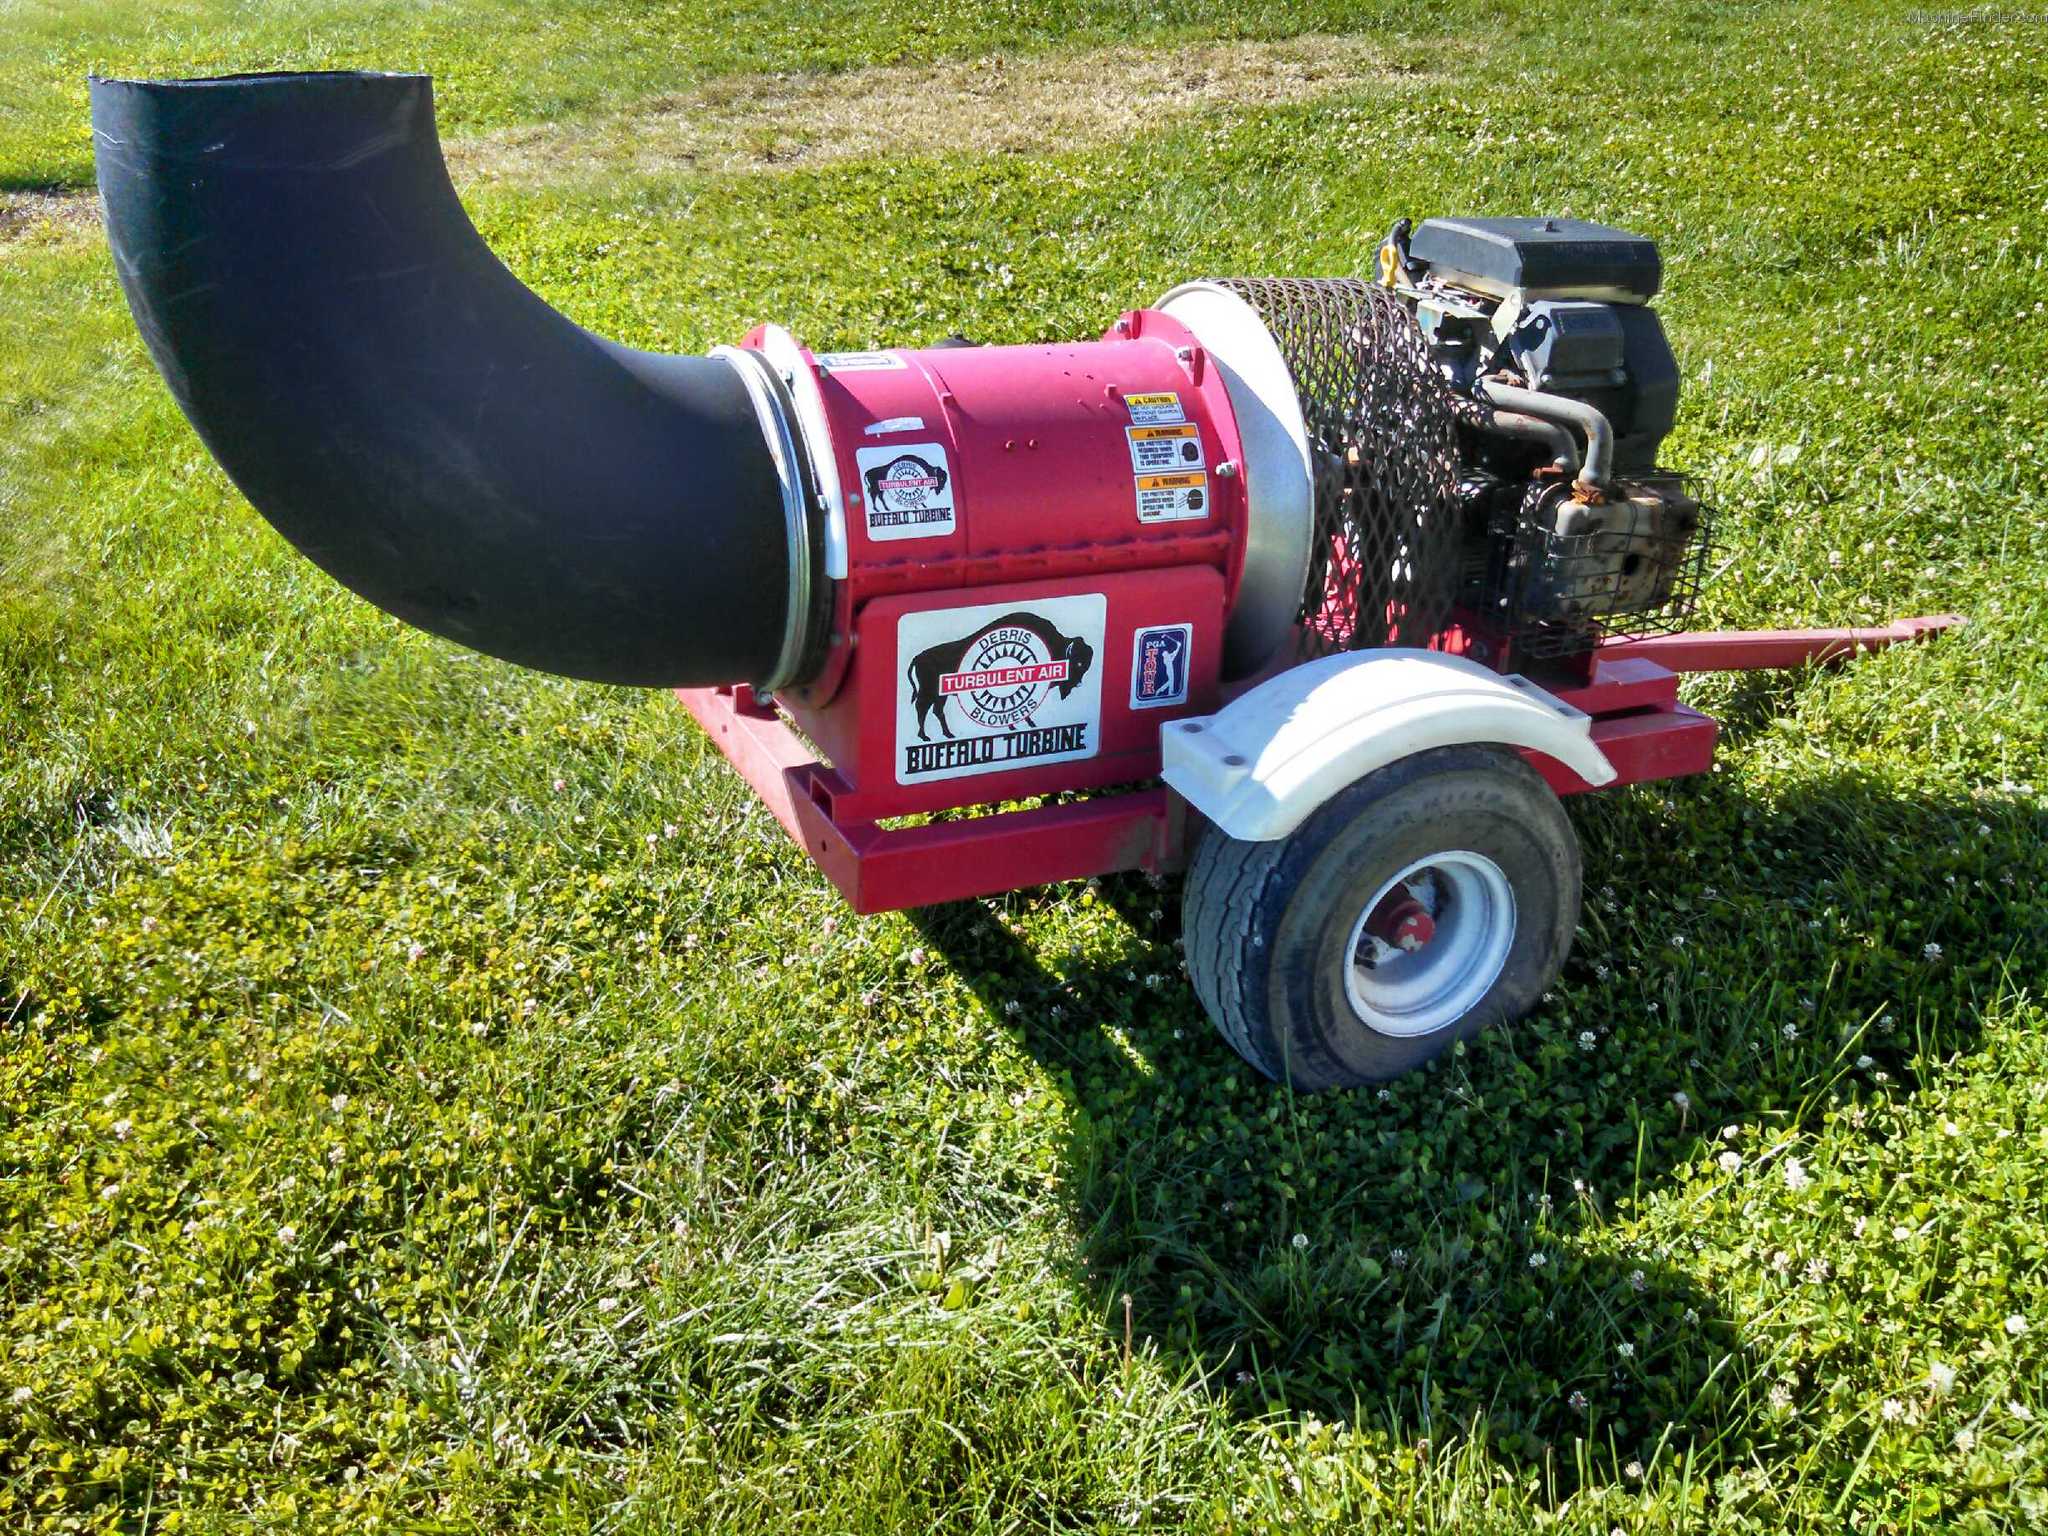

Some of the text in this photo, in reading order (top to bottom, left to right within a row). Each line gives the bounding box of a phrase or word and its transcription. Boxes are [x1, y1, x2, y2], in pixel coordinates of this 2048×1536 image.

[1155, 429, 1183, 437] WARNING
[881, 478, 936, 490] TURBULENT AIR
[1162, 477, 1191, 486] WARNING
[869, 507, 952, 527] BUFFALO TURBINE
[978, 629, 1032, 649] DEBRIS
[1146, 640, 1166, 648] PGA
[944, 665, 1063, 691] TURBULENT AIR
[1143, 648, 1159, 695] TOUR
[970, 699, 1038, 726] BLOWERS
[905, 723, 1088, 775] BUFFALO TURBINE
